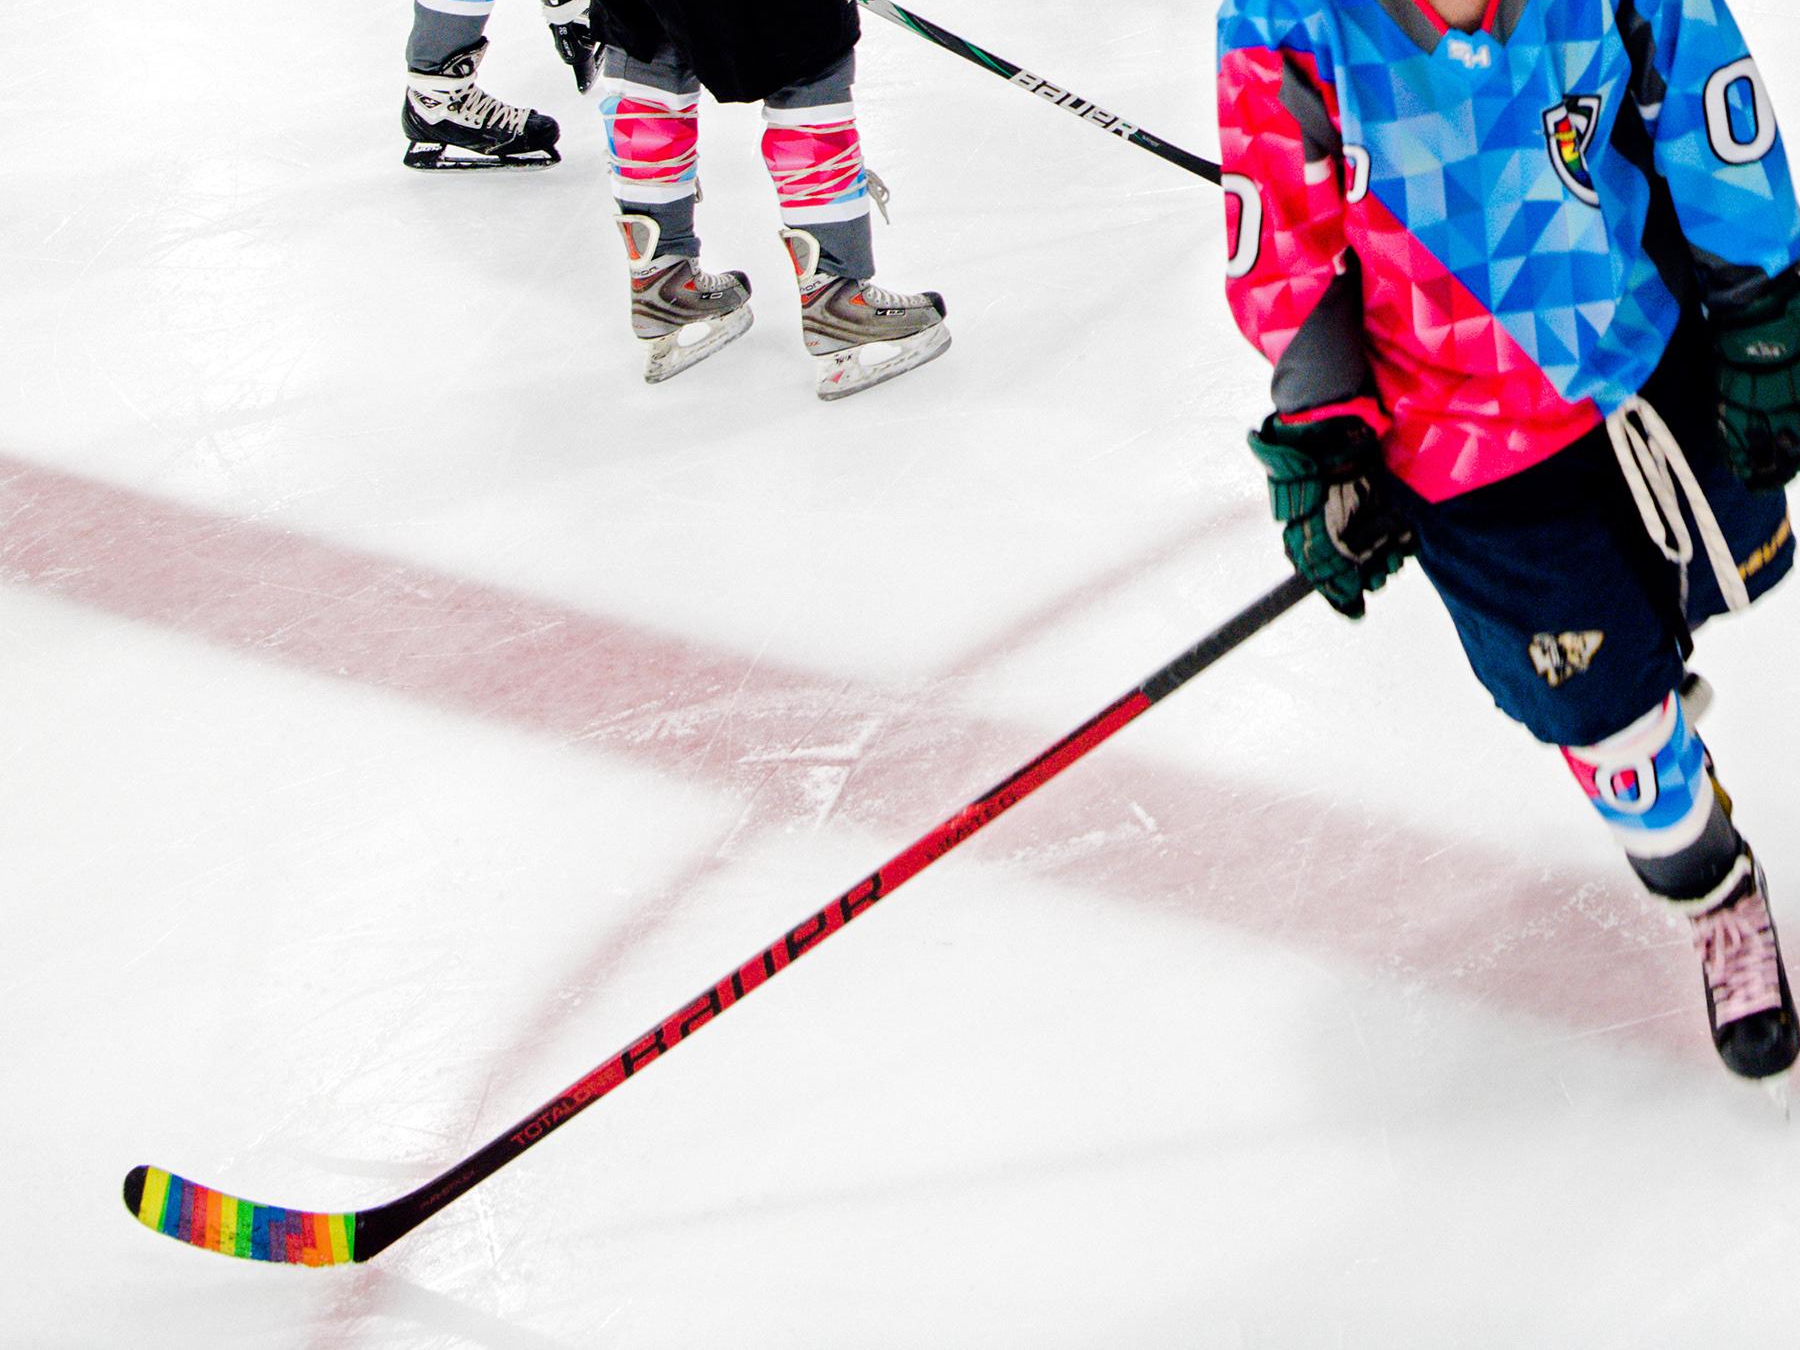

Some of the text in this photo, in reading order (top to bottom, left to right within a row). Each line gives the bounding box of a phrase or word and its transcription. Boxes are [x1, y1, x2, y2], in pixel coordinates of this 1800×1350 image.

[1010, 68, 1141, 141] BAUER
[1702, 55, 1779, 166] 0
[1594, 752, 1660, 814] 0
